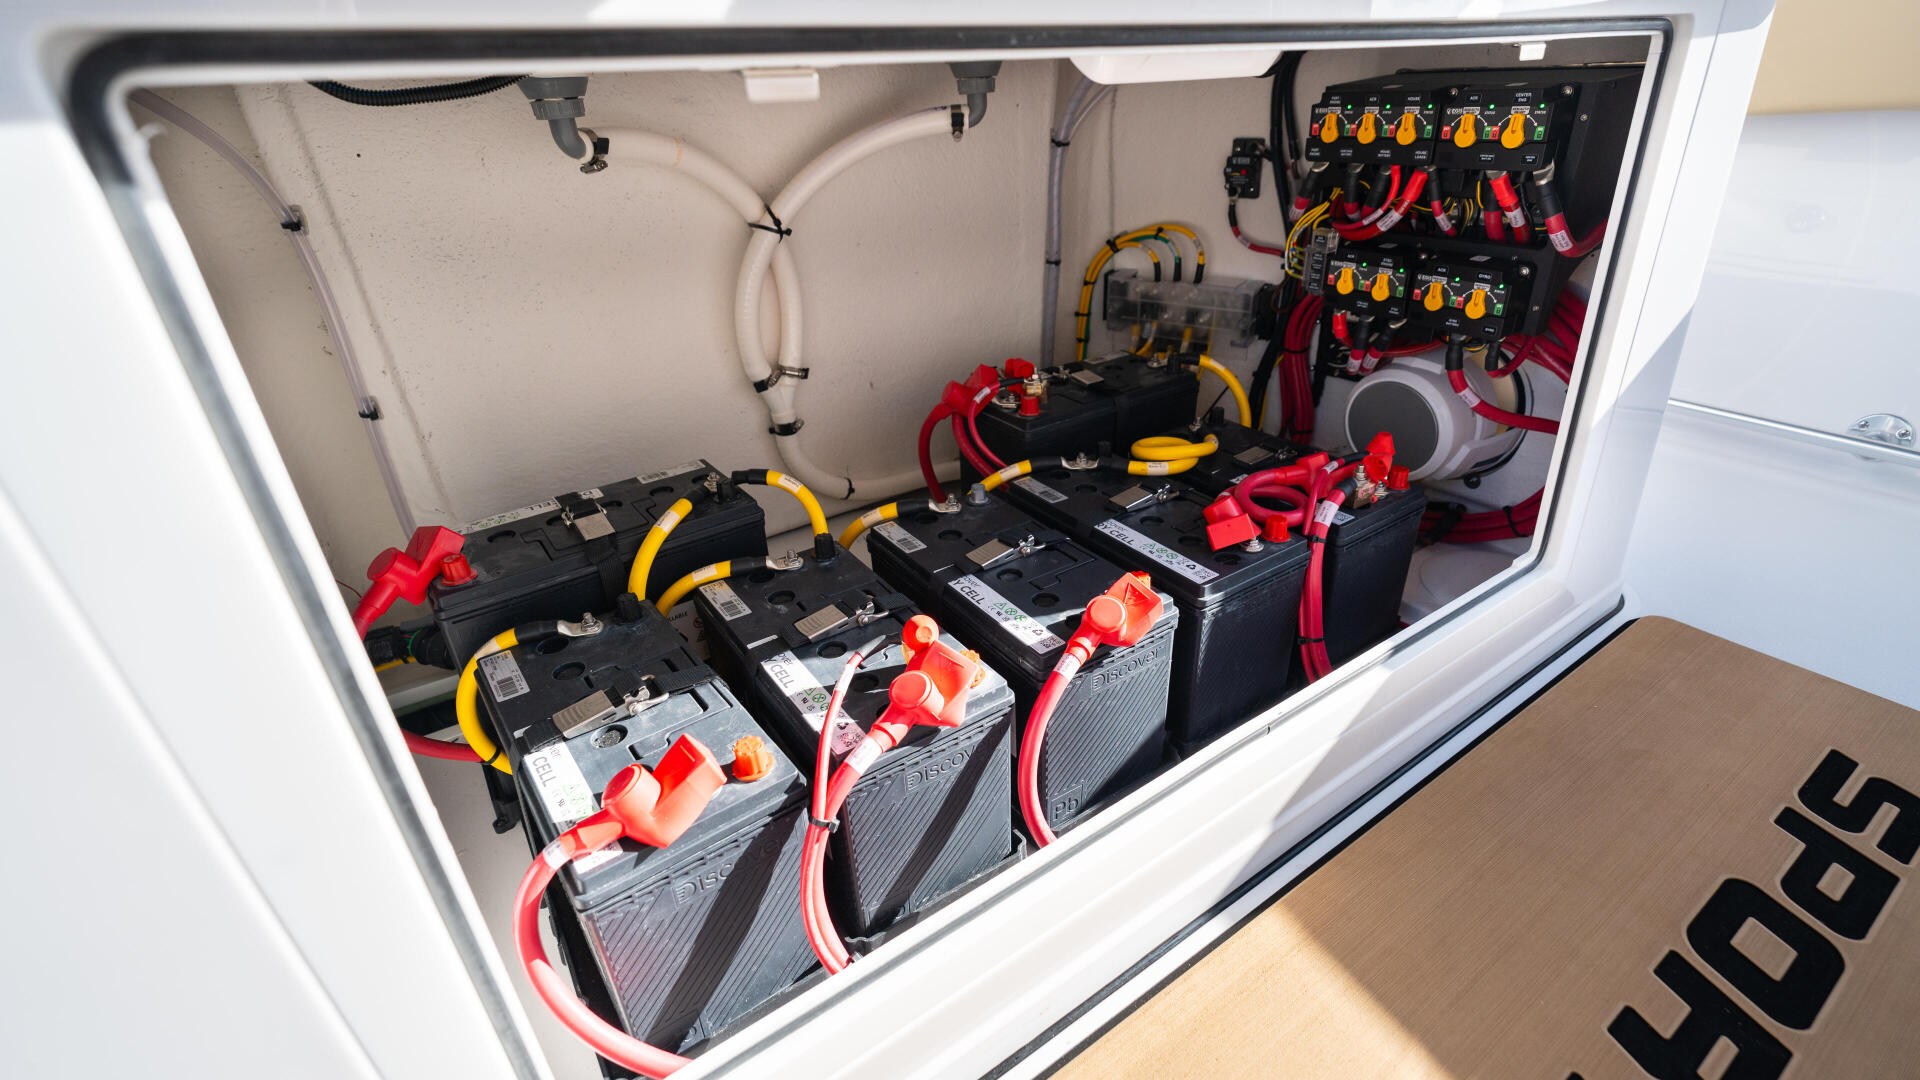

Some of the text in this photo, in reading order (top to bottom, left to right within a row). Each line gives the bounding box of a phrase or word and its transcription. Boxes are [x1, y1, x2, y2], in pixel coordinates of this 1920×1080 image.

[1109, 529, 1135, 546] CELL
[960, 586, 985, 604] CELL
[770, 664, 794, 688] CELL
[1093, 646, 1162, 692] Discover
[532, 756, 556, 787] CELL
[1053, 797, 1079, 821] Pb
[1566, 749, 1920, 1080] SPOR
